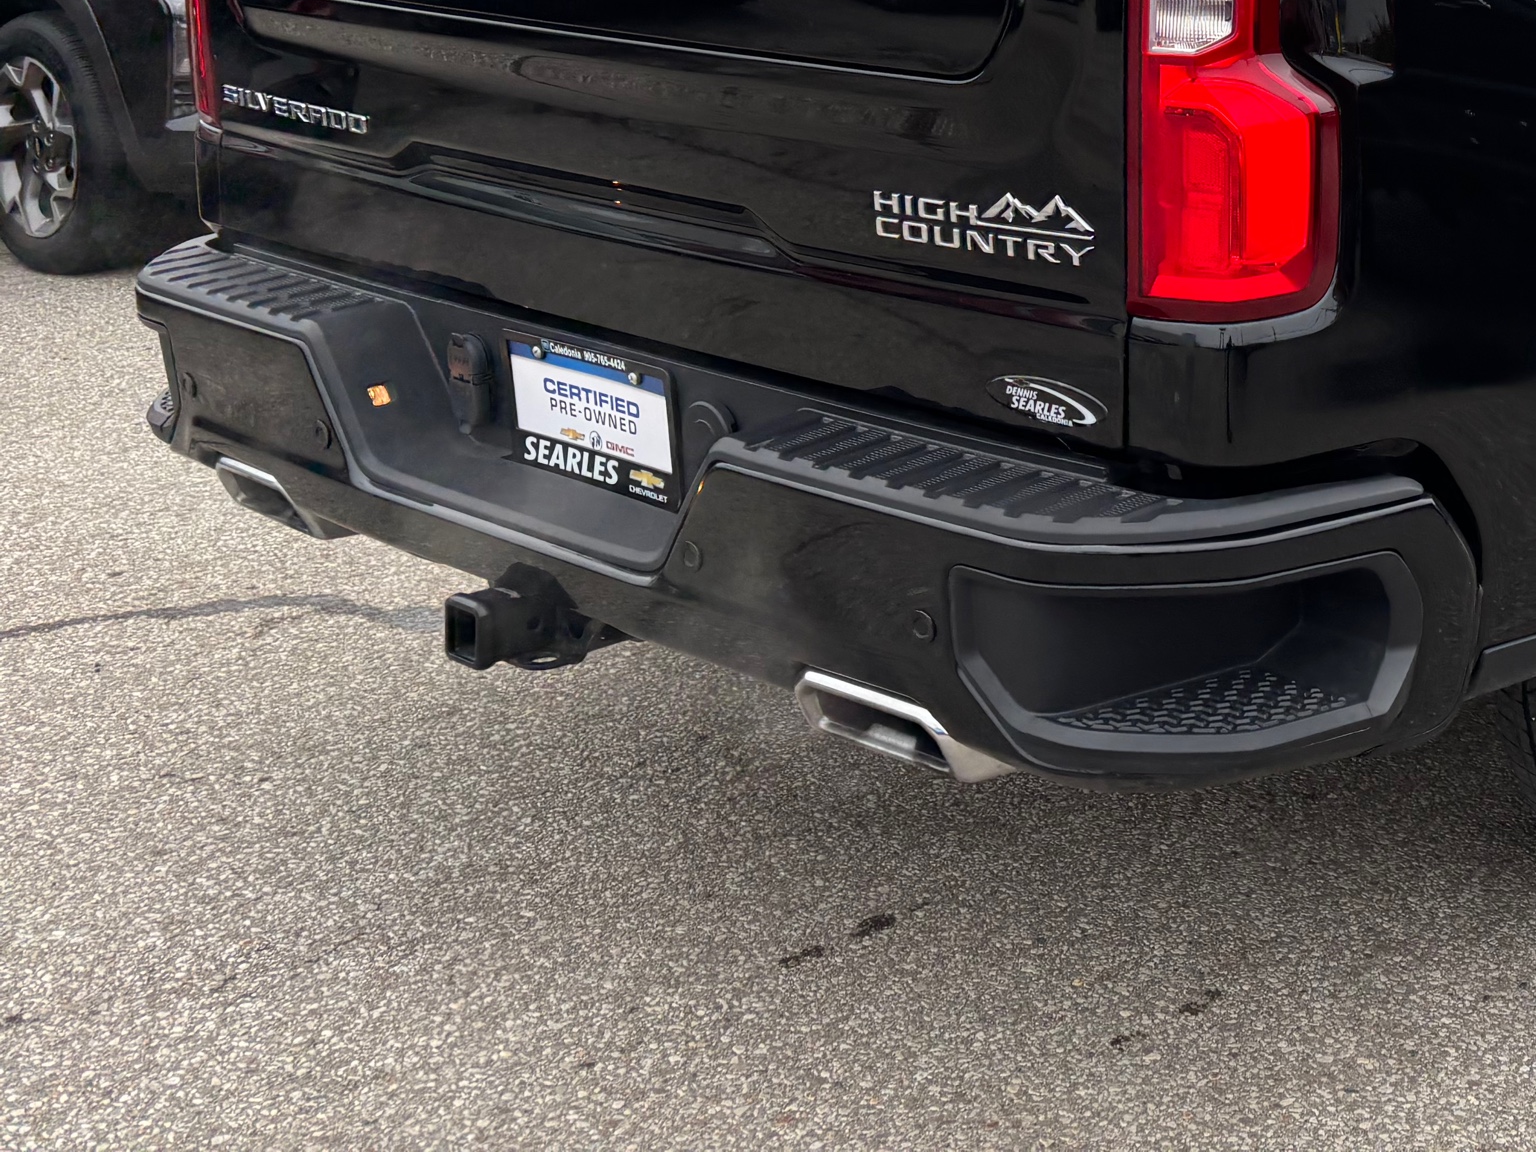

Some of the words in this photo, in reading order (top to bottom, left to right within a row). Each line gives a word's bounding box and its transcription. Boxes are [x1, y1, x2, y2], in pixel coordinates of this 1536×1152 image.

[222, 84, 370, 134] SILVERADO
[873, 190, 978, 226] HIGH
[875, 216, 1095, 267] COUNTRY
[549, 342, 582, 360] Caledonia
[583, 350, 626, 371] 905-765-4424
[543, 377, 640, 419] CERTIFIED
[1006, 385, 1038, 400] DENNIS
[1011, 396, 1067, 419] SEARLES
[550, 397, 638, 435] PRE-OWNED
[1036, 413, 1074, 427] CALEDONIA
[523, 436, 619, 485] SEARLES
[606, 440, 635, 458] GMC
[629, 484, 668, 504] CHEVROLET
